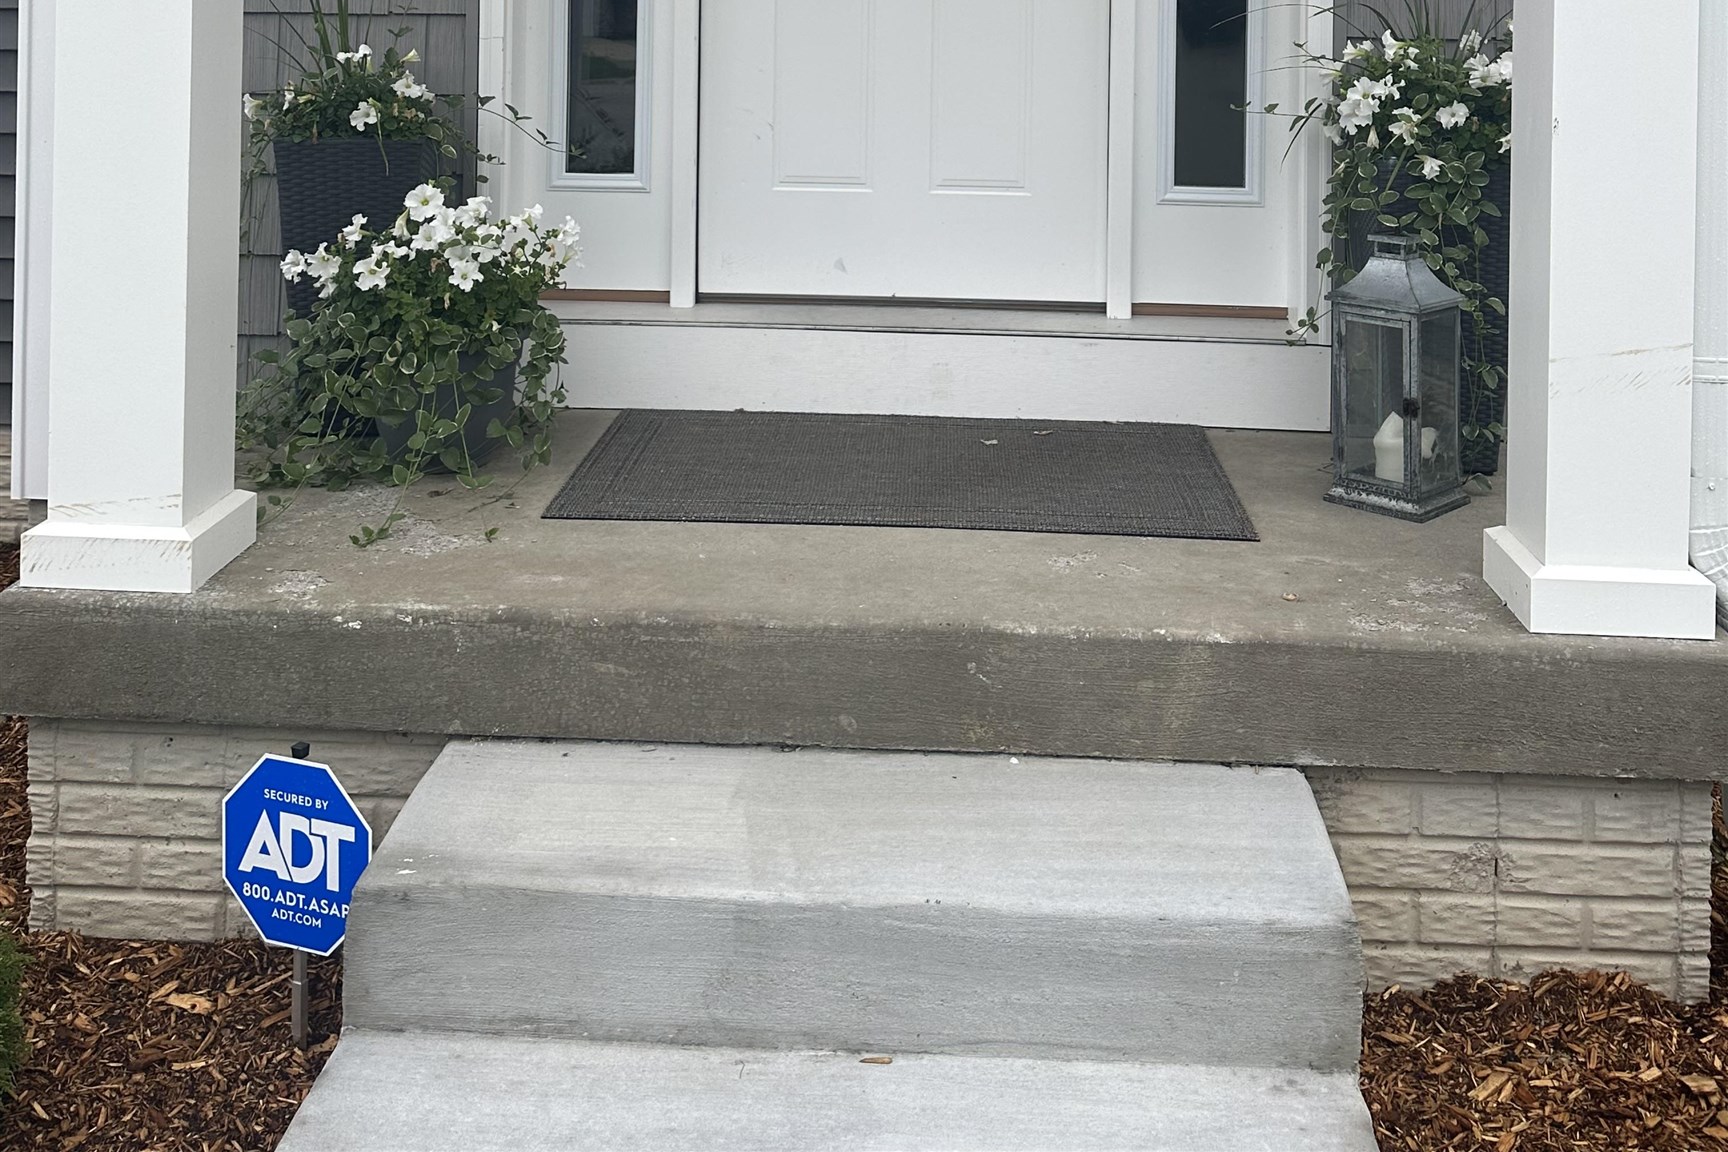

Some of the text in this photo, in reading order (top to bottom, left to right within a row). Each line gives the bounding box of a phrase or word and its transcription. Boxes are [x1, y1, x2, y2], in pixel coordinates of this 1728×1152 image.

[264, 788, 329, 810] SECURED BY
[238, 808, 356, 892] ADT
[242, 881, 350, 918] 800.ADT.ASAP
[271, 908, 322, 928] ADT.COM
